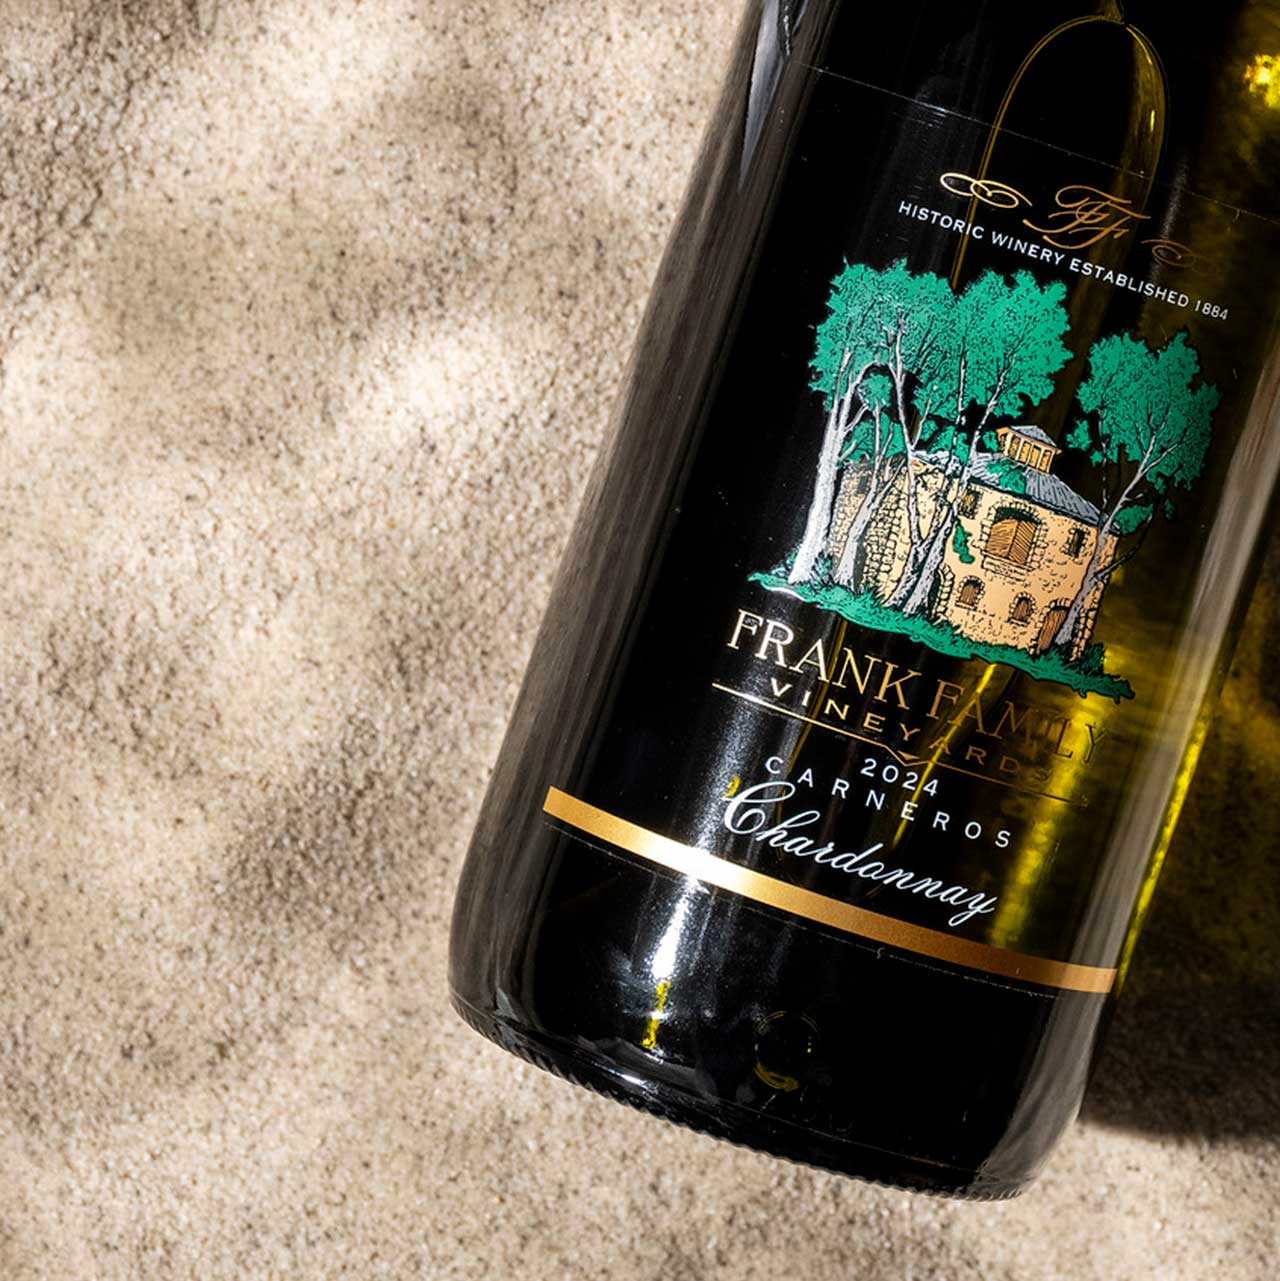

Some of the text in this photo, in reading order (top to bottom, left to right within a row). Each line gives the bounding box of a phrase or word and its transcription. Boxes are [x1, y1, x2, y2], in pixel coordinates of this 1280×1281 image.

[898, 200, 1229, 321] HISTORIC WINERY ESTABLISHED 1884
[726, 608, 1108, 766] FRANK FAMILY
[770, 677, 1052, 783] VINEYARDS
[765, 756, 1011, 848] CARNEROS
[861, 758, 939, 797] 2024
[722, 780, 997, 927] Chardonnay
